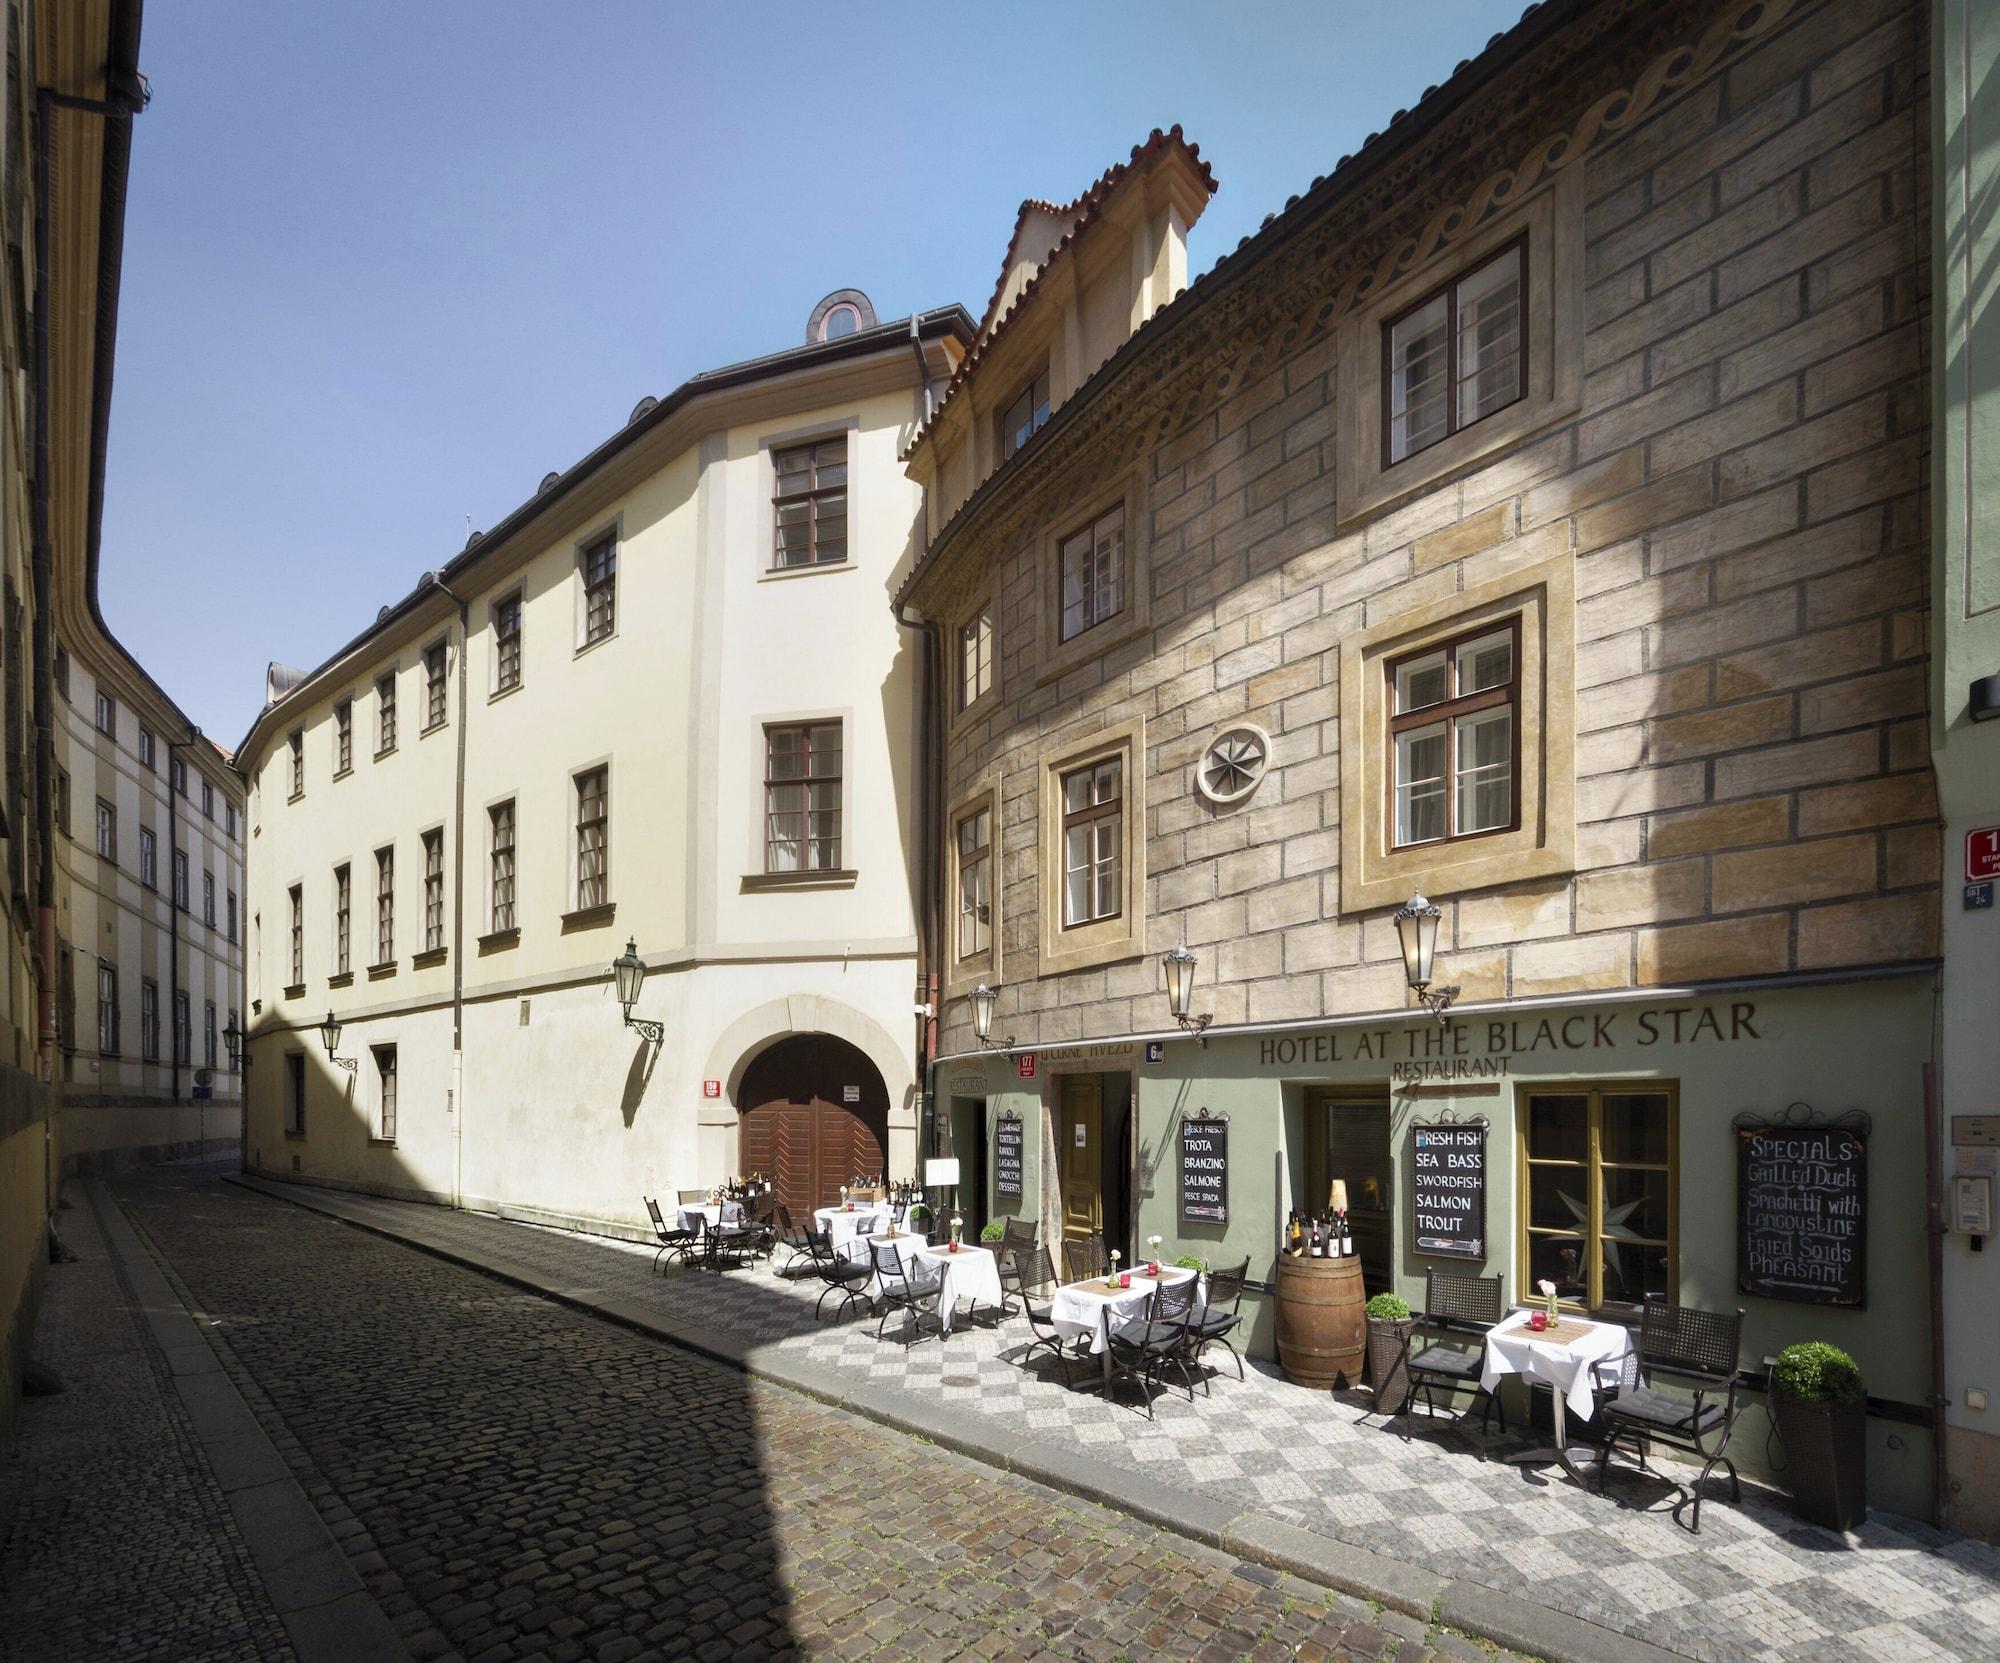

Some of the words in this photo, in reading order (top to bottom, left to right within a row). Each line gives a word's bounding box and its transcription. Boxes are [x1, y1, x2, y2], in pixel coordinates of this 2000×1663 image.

[1260, 1035, 1343, 1065] HOTEL
[1353, 1031, 1392, 1060] AT
[1404, 1025, 1469, 1058] THE
[1487, 1014, 1618, 1053] BLACK
[1637, 1003, 1761, 1046] STAR
[1393, 1056, 1512, 1081] RESTAURANT
[1184, 1140, 1212, 1151] TROTA
[1416, 1130, 1453, 1147] FRESH
[1457, 1132, 1482, 1146] FISH
[1184, 1157, 1225, 1170] BRANZINO
[1416, 1153, 1439, 1167] SEA
[1448, 1154, 1482, 1168] BASS
[1184, 1174, 1221, 1187] SALMONE
[1416, 1175, 1482, 1188] SWORDFISH
[1185, 1192, 1201, 1201] PESCE
[1416, 1194, 1471, 1210] SALMON
[1828, 1194, 1861, 1217] with
[1417, 1214, 1463, 1231] TROUT
